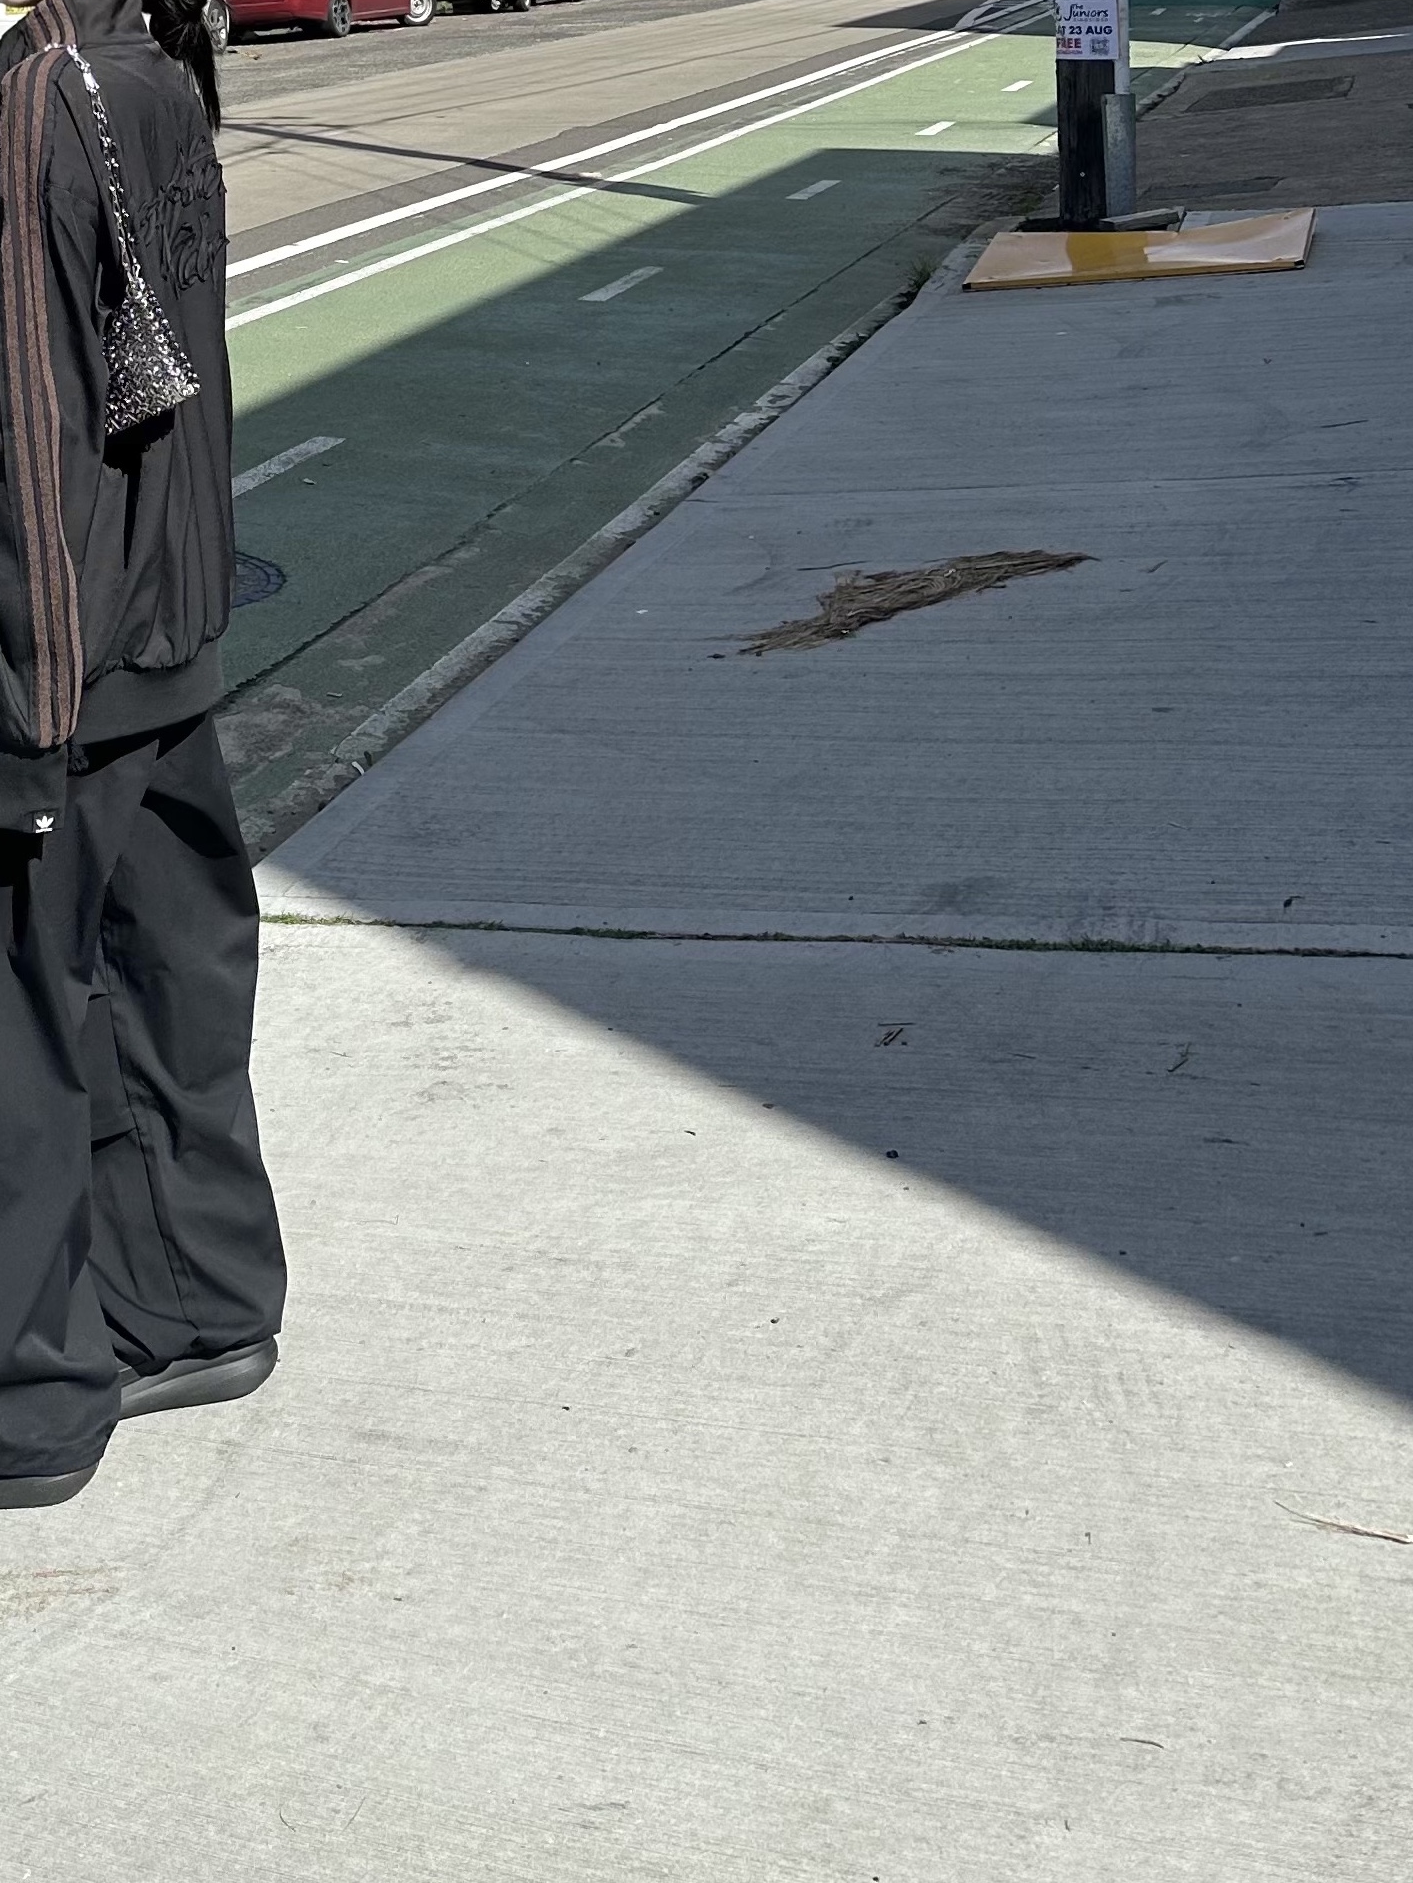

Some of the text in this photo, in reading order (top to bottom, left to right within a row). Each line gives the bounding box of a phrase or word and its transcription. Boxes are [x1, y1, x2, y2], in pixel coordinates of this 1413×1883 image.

[1069, 25, 1082, 35] 23
[1085, 25, 1113, 35] AUG
[1056, 37, 1082, 48] FREE
